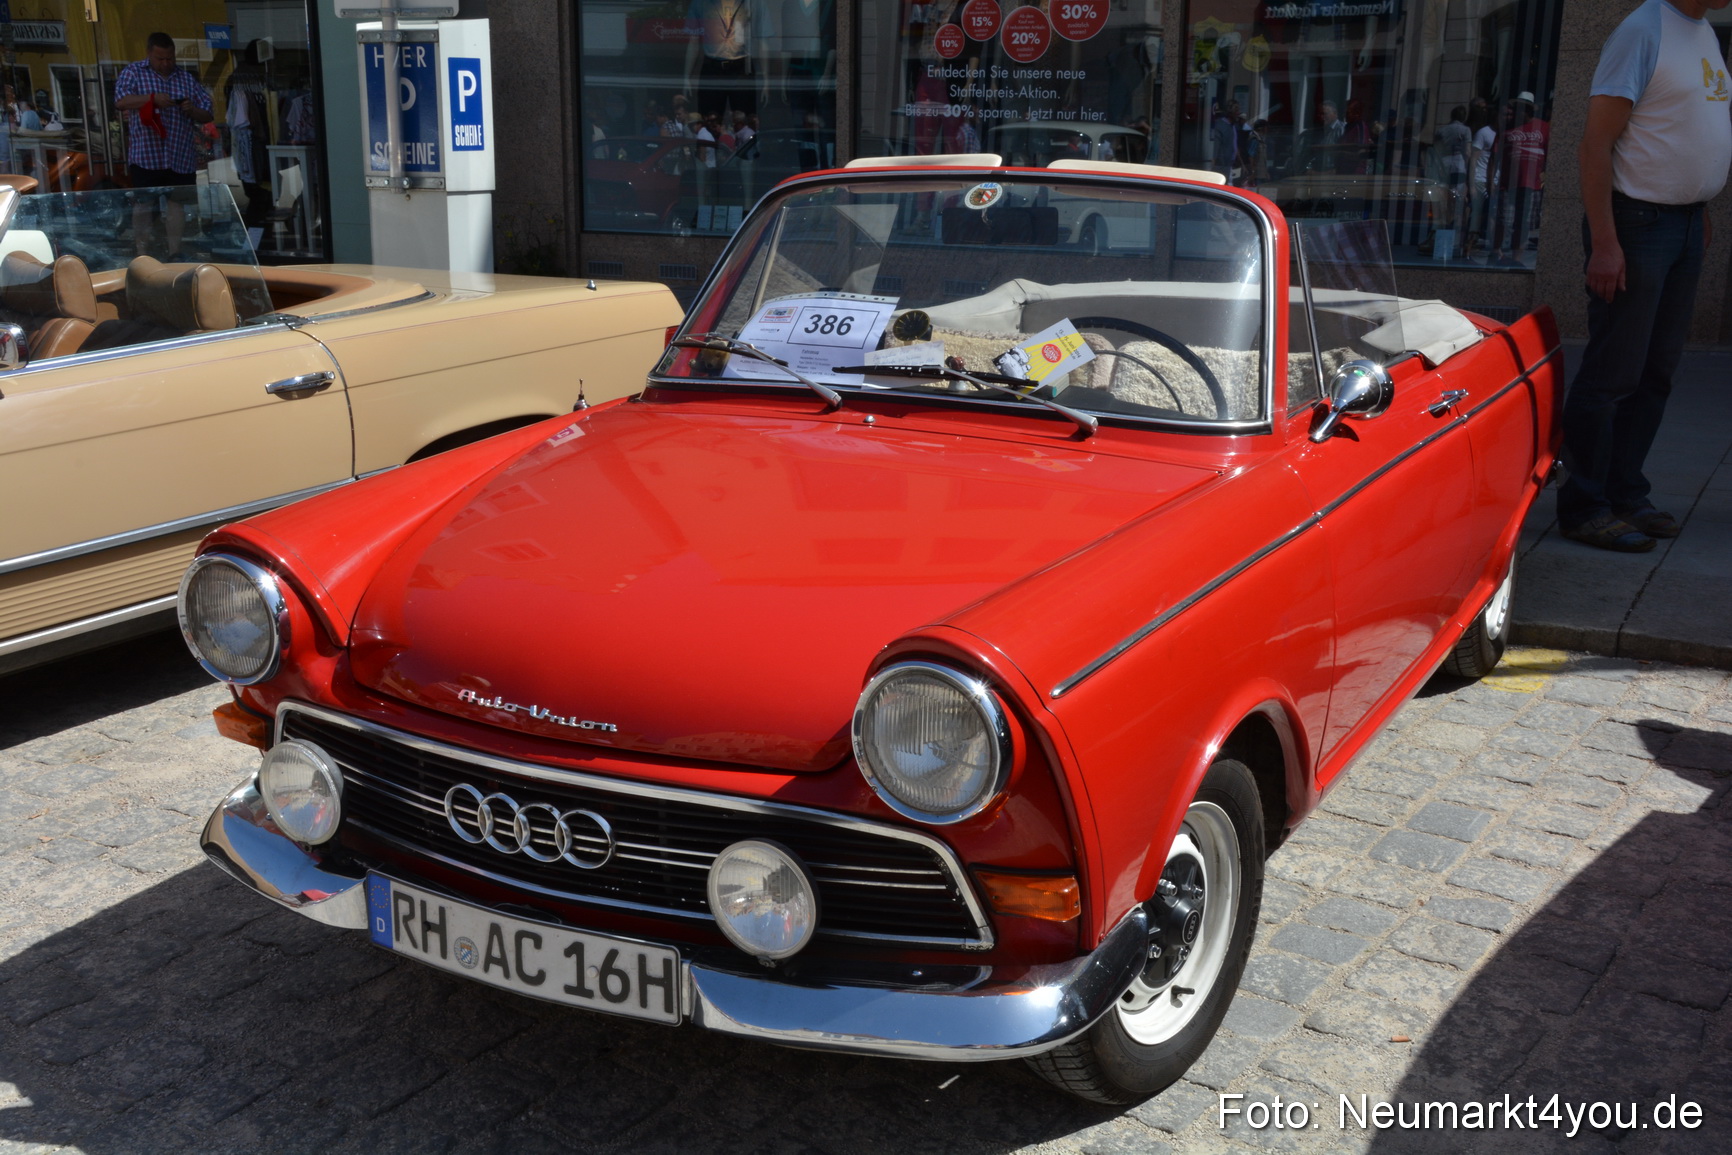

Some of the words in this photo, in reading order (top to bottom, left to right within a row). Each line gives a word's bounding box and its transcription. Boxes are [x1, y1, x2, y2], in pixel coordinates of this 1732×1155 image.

[1061, 4, 1097, 19] 30%
[972, 16, 993, 27] 15%
[941, 39, 959, 48] 10%
[1011, 32, 1041, 45] 20%
[374, 46, 427, 68] HER
[927, 65, 986, 79] Entdecken
[990, 65, 1008, 79] Sie
[1012, 68, 1052, 79] unsere
[1056, 69, 1086, 79] neue
[457, 70, 477, 112] P
[949, 84, 1061, 101] Staffelpreis-Aktion.
[905, 104, 921, 117] Bis
[925, 107, 939, 117] zu
[943, 104, 975, 118] 30%
[978, 108, 1022, 122] sparen.
[1026, 106, 1053, 121] Jetzt
[1056, 110, 1076, 120] nur
[1080, 107, 1107, 121] hier.
[374, 141, 436, 165] SCEINE
[804, 313, 855, 336] 386
[376, 916, 386, 933] D
[392, 889, 448, 960] RH
[483, 922, 547, 987] AC
[563, 940, 674, 1014] 16H
